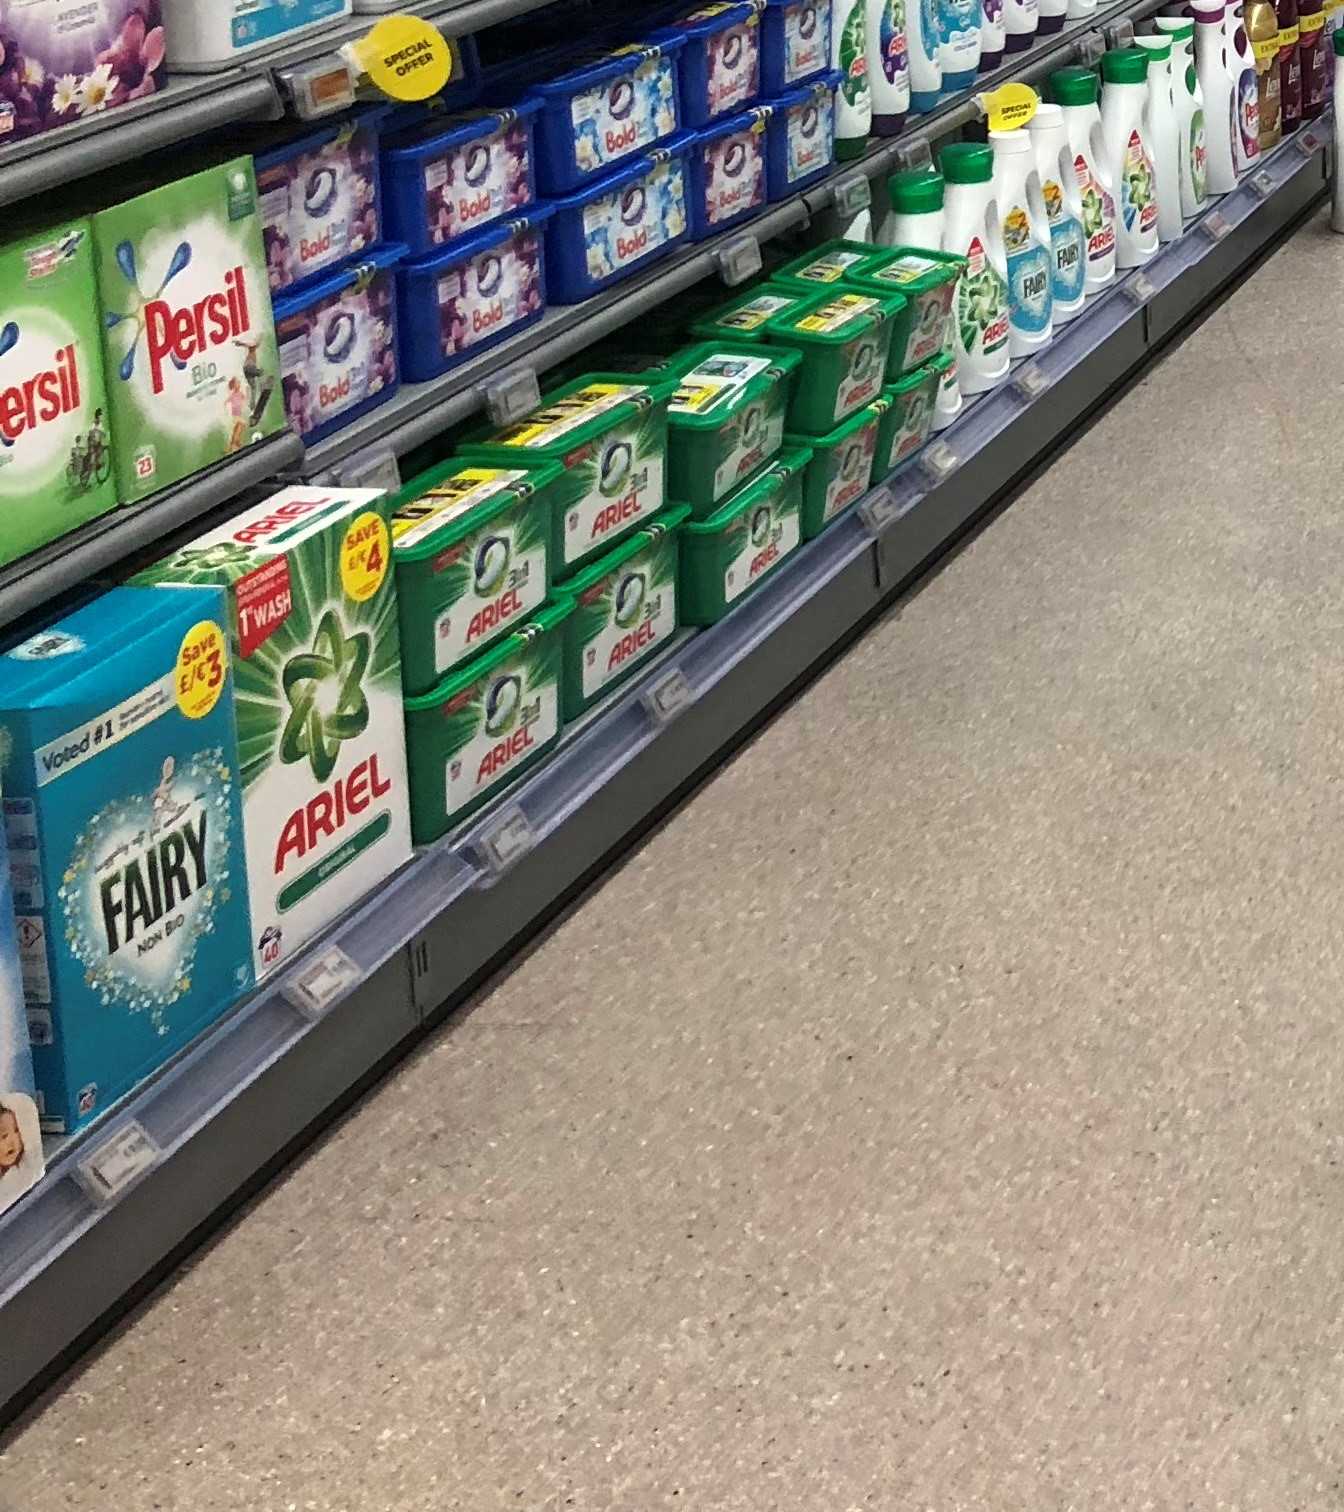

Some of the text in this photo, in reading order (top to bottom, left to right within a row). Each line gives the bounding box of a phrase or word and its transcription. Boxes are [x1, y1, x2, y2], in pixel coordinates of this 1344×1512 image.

[385, 39, 432, 68] SPECIAL
[396, 52, 434, 77] OFFER
[144, 265, 250, 395] Persil
[0, 343, 81, 442] ersil
[191, 361, 218, 384] Bio
[233, 494, 332, 545] ARIEL
[347, 519, 380, 551] SAVE
[591, 492, 642, 538] ARIEL
[253, 589, 291, 629] WASH
[466, 590, 522, 644] ARIEL
[183, 633, 216, 666] Save
[608, 620, 656, 672] ARIEL
[43, 719, 115, 772] Voted #1
[477, 729, 533, 784] ARIEL
[274, 753, 391, 873] ARIEL
[100, 810, 207, 955] FAIRY
[137, 914, 185, 957] NON BIO
